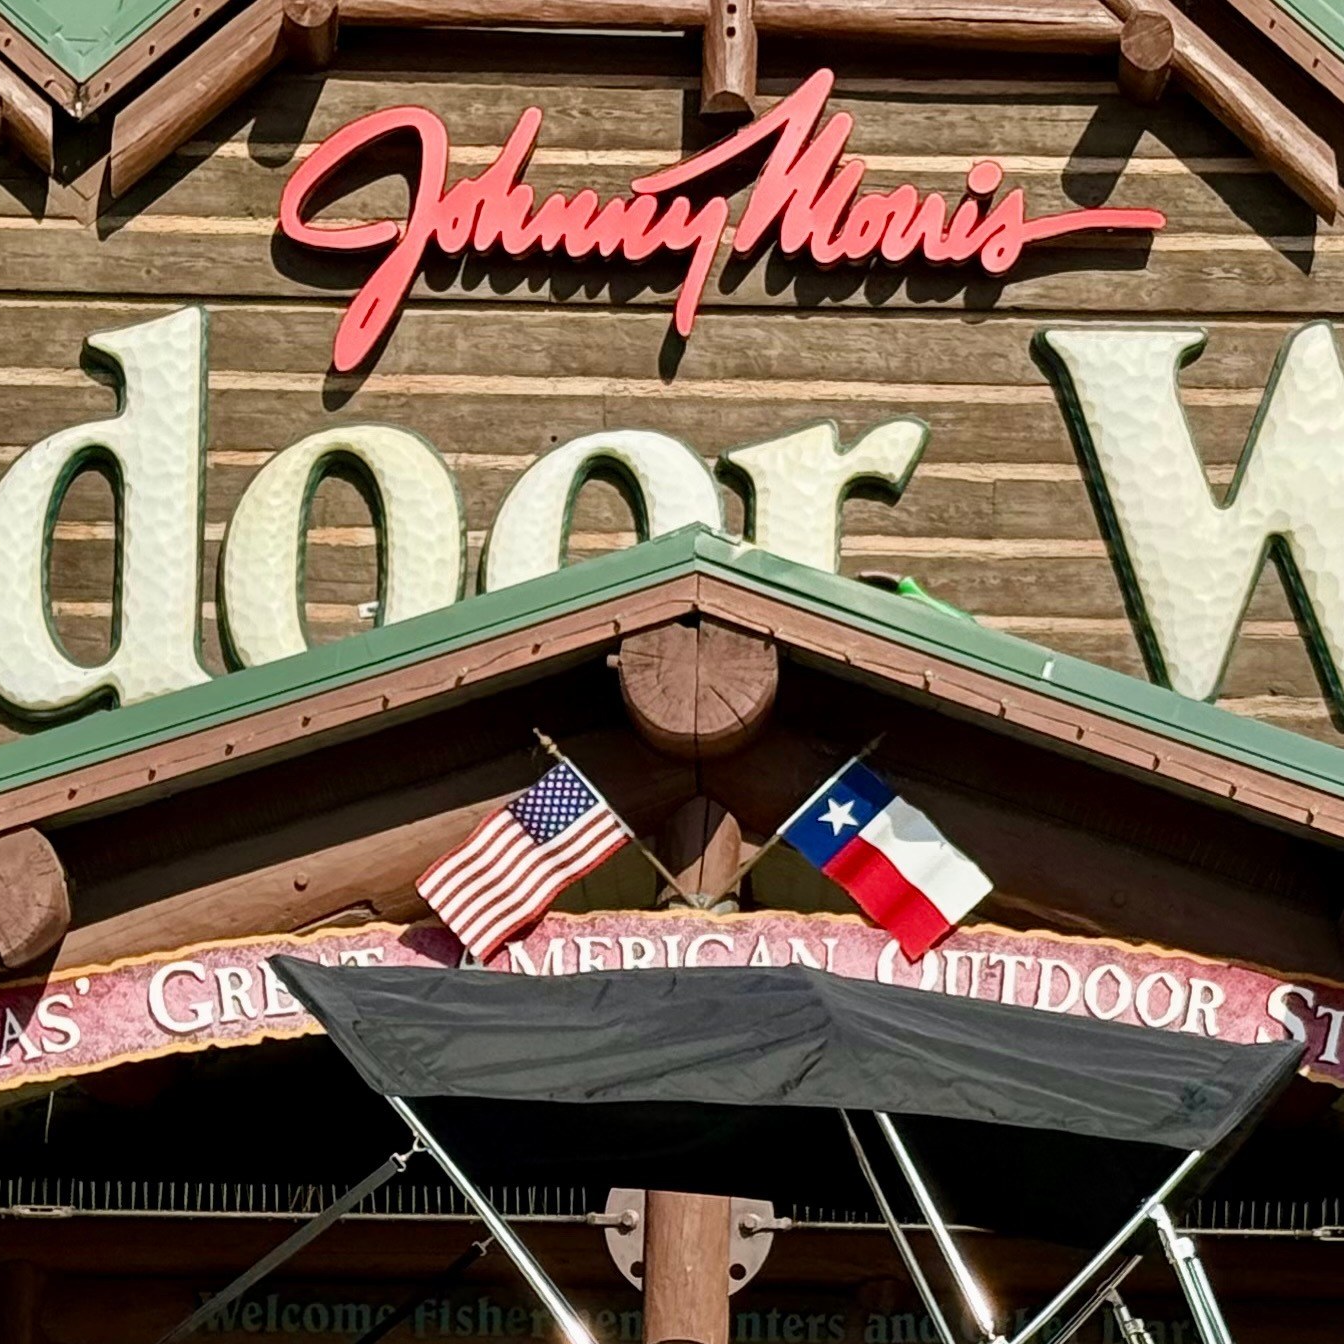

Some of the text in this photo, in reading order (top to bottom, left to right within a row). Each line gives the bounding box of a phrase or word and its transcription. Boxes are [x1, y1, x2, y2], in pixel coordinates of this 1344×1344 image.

[279, 68, 1167, 372] Johnny Morris
[148, 946, 387, 1034] GRE
[460, 933, 839, 977] MERICAN
